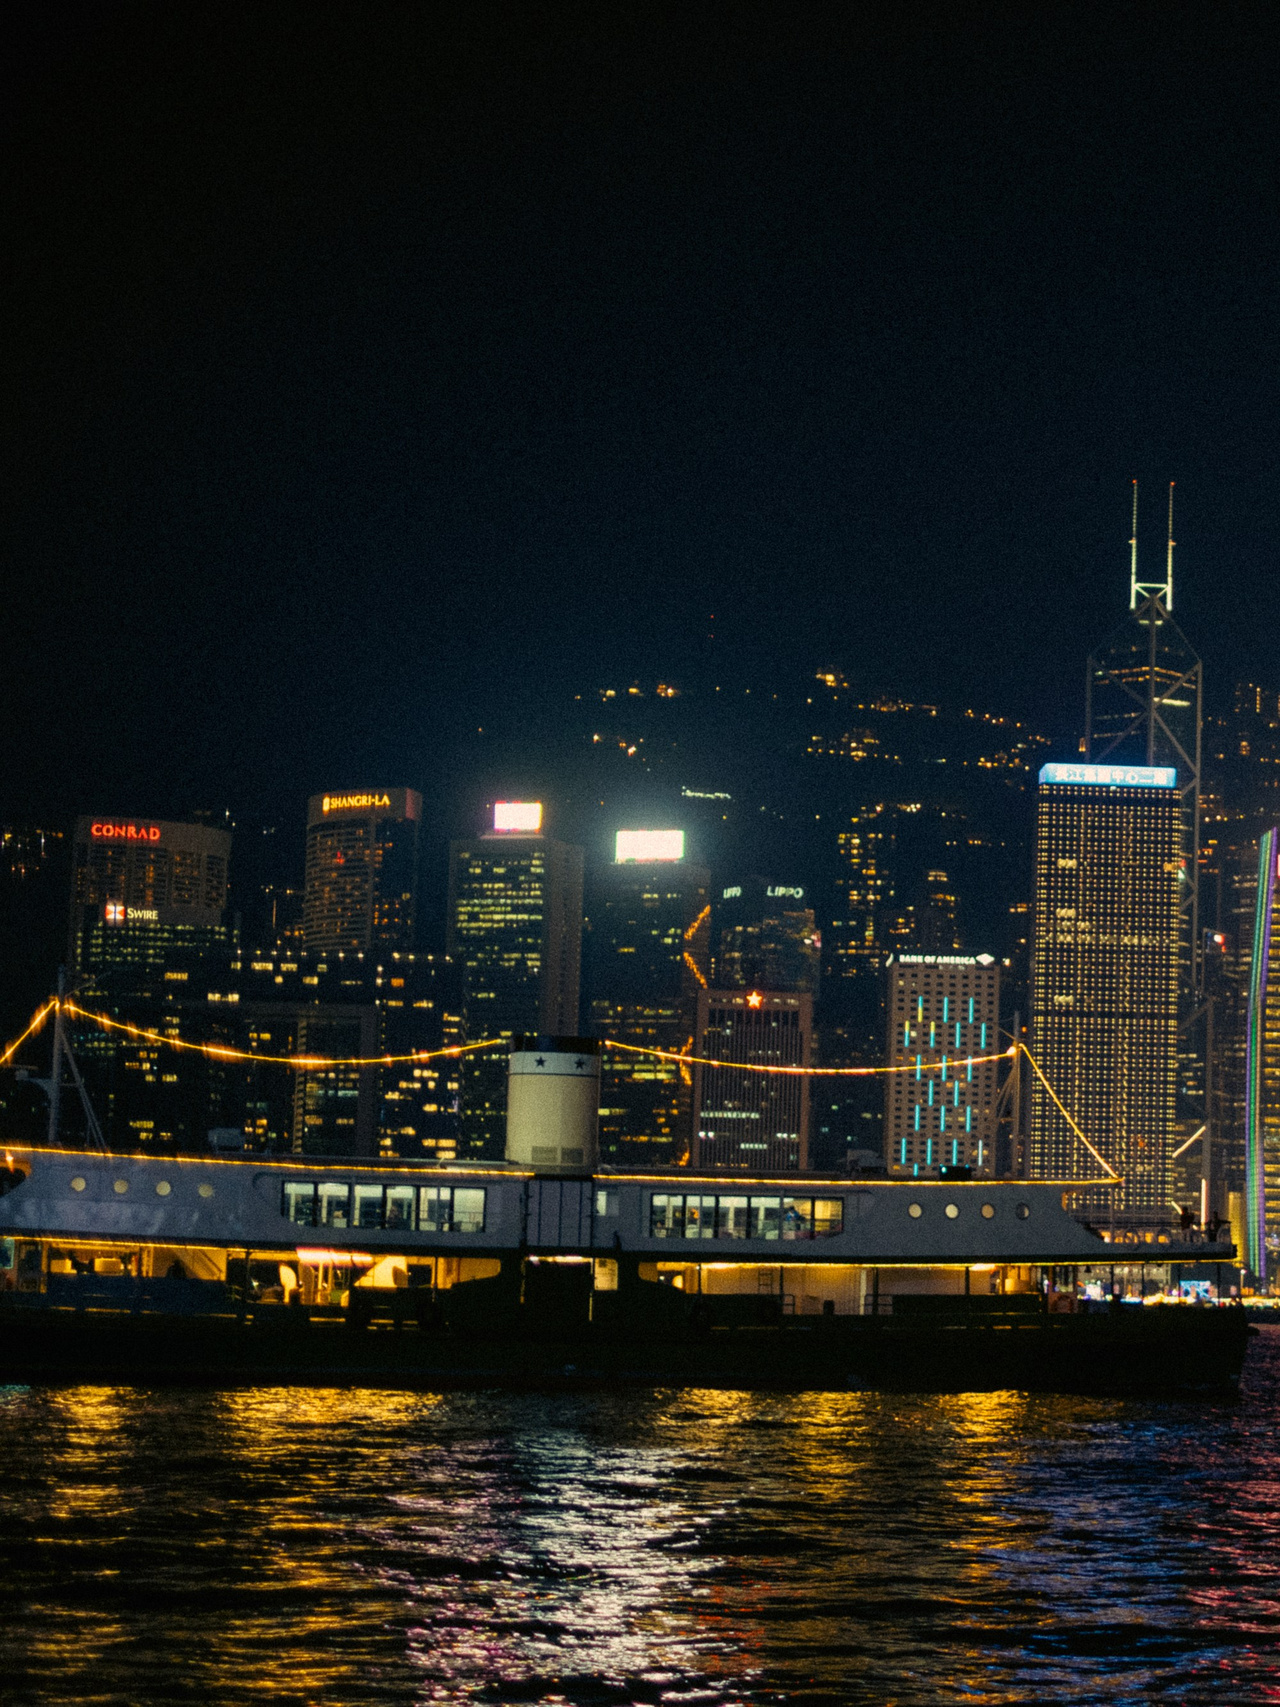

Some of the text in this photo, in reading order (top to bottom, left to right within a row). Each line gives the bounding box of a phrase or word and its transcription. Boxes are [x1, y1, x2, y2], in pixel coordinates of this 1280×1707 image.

[330, 794, 391, 809] SHANGRI-LA
[91, 823, 161, 840] CONRAD
[766, 885, 804, 899] LIPPO
[899, 954, 977, 965] BANK OF AMERICA
